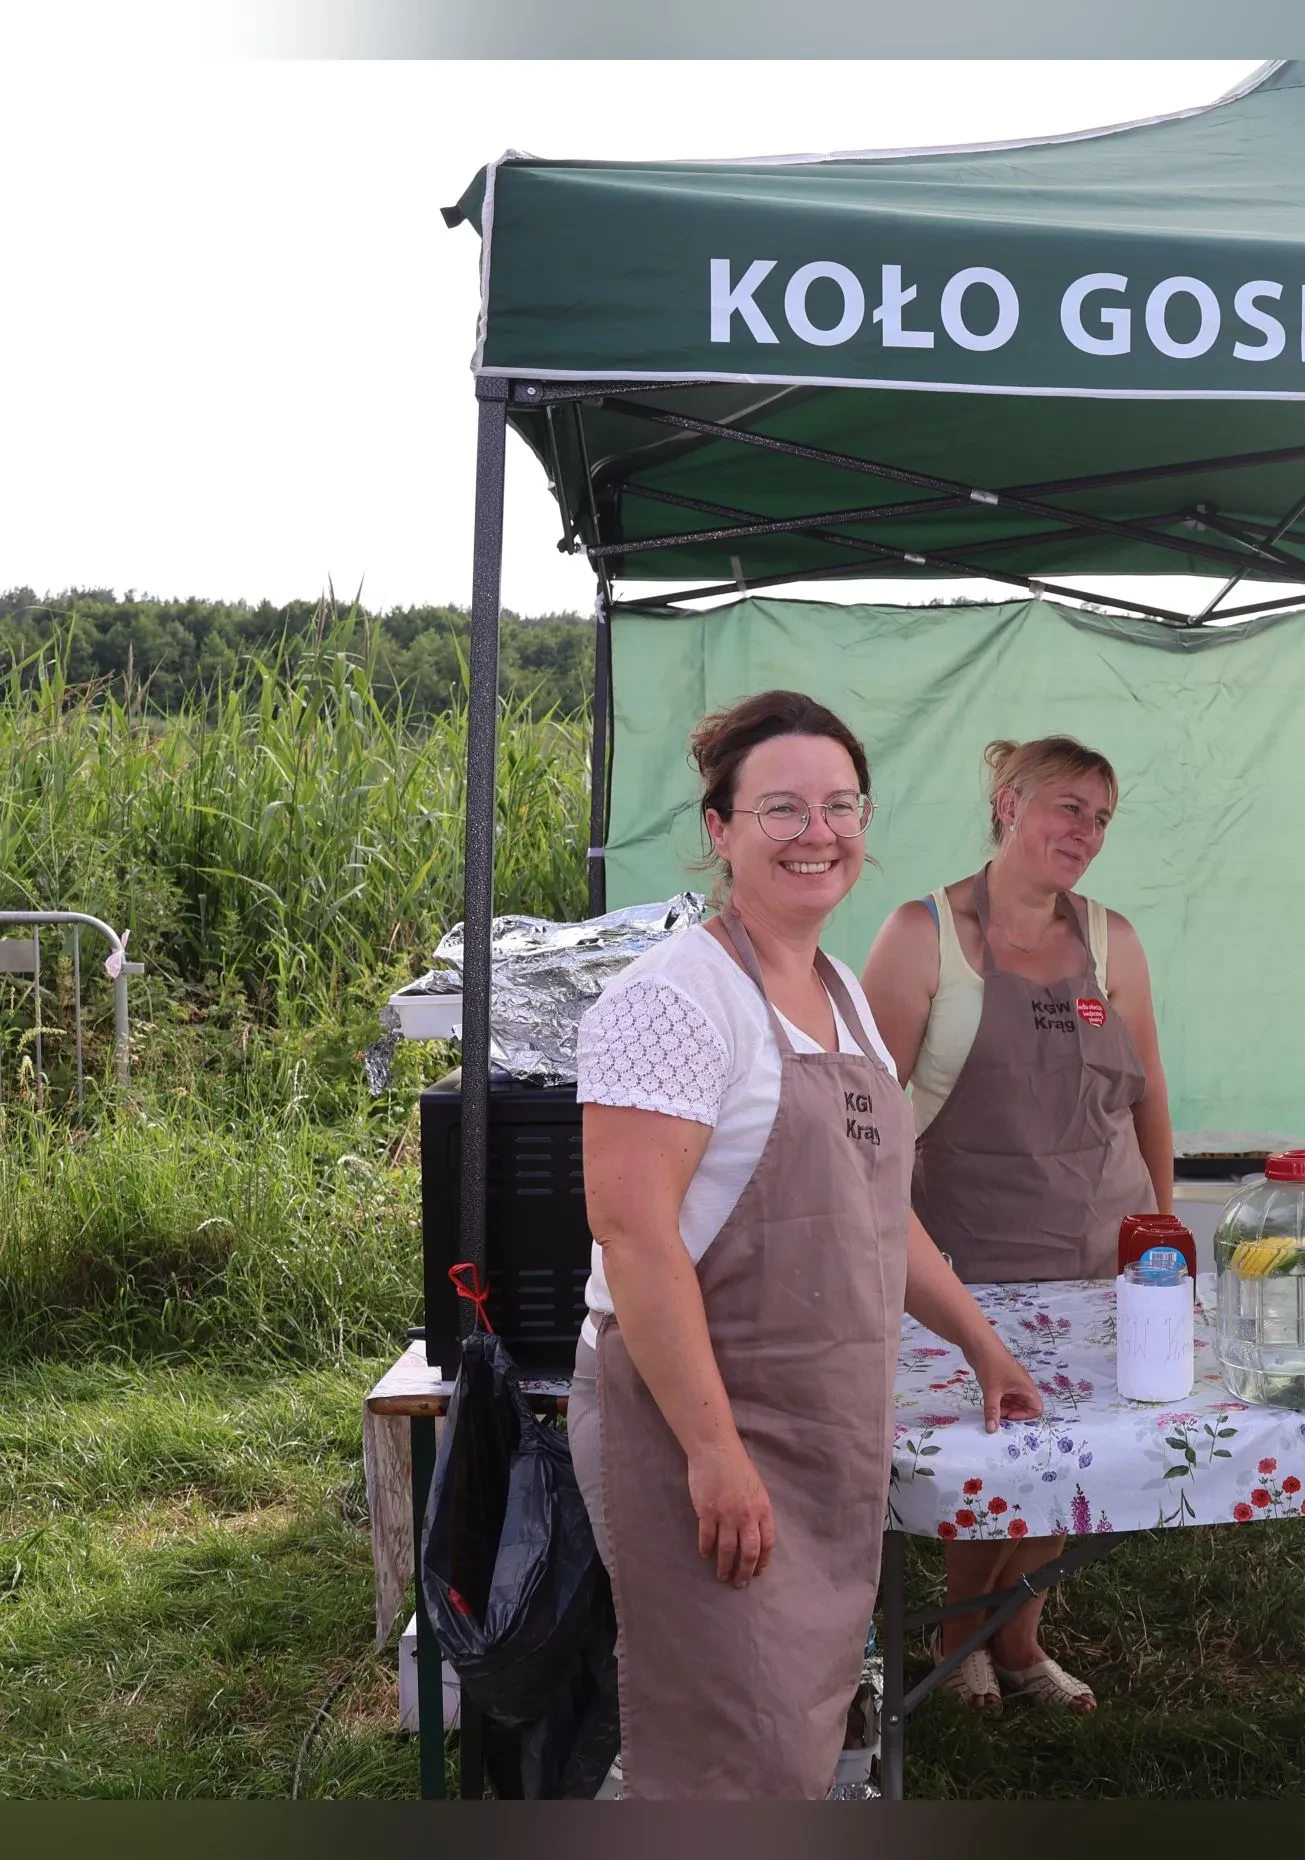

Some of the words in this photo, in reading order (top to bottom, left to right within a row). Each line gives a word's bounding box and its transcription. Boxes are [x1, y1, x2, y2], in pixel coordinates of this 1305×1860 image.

[708, 258, 1020, 352] KOŁO
[1031, 1000, 1071, 1015] KGW
[1034, 1016, 1076, 1033] Krąg
